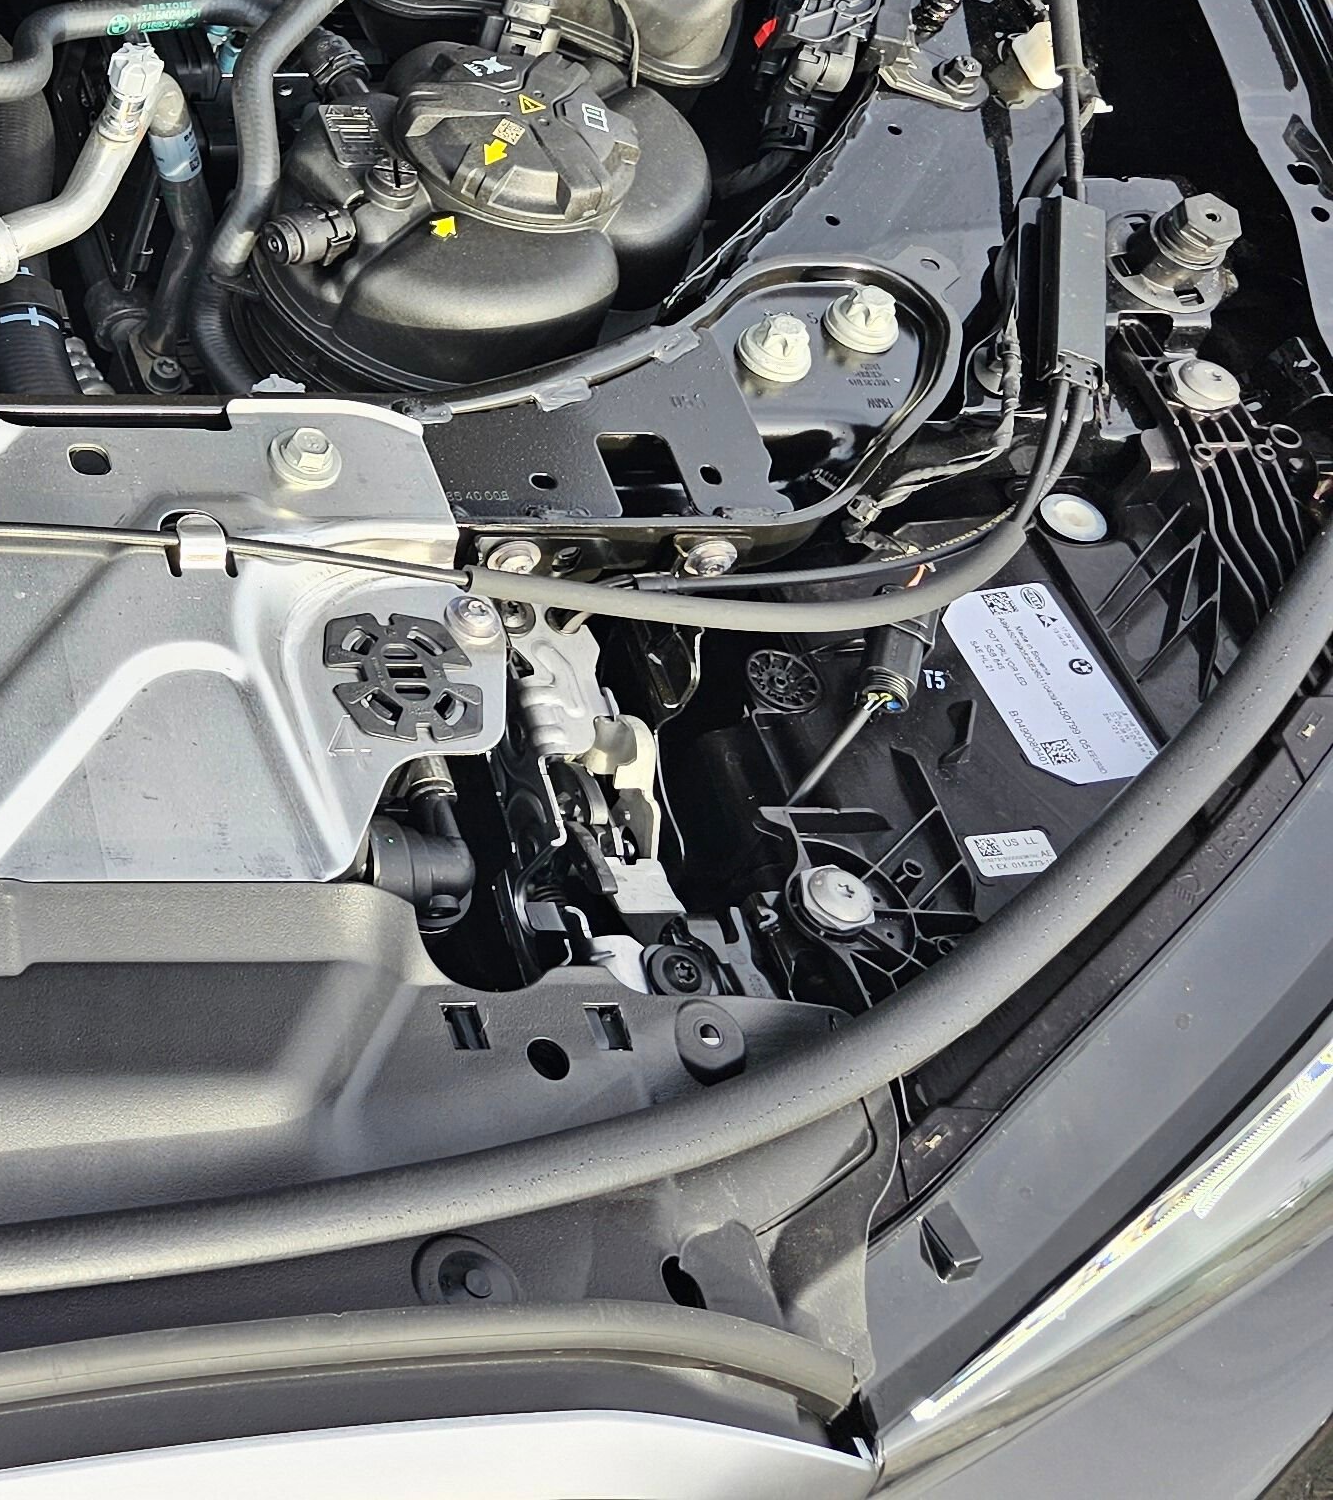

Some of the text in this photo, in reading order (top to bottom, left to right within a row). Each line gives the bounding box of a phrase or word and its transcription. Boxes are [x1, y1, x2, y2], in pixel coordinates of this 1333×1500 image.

[923, 669, 946, 689] T5
[1003, 836, 1039, 847] US LL
